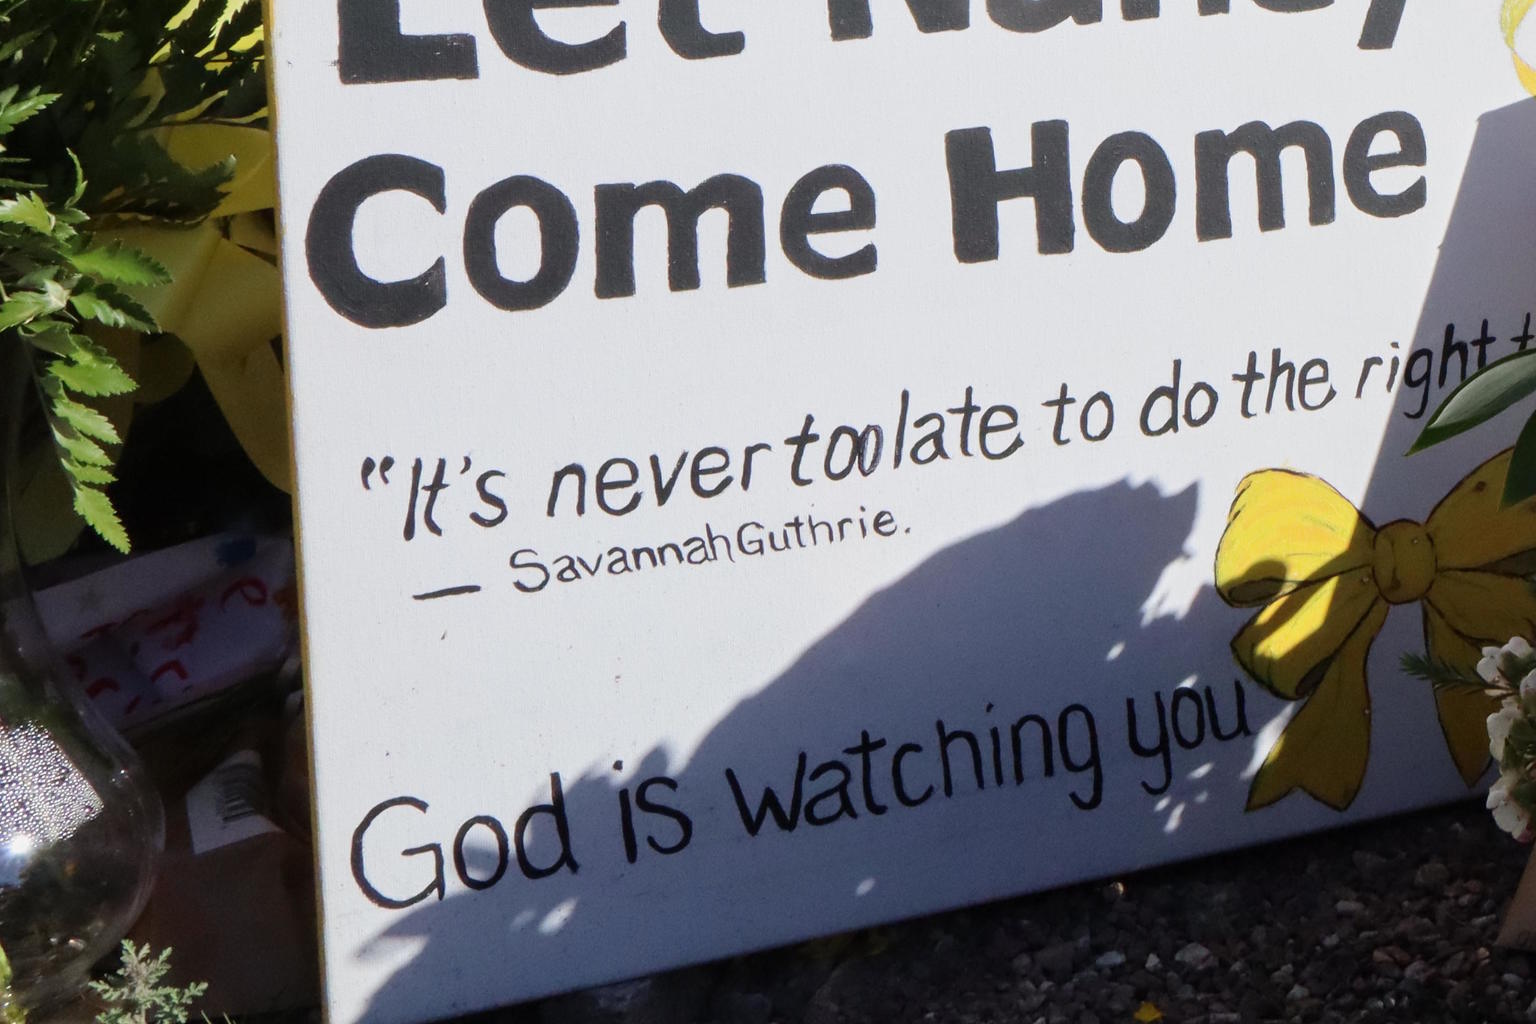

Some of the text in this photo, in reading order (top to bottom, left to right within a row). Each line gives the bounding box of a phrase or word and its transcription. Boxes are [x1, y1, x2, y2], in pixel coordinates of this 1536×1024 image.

[305, 110, 1427, 329] Come Home
[546, 442, 772, 517] never
[1041, 382, 1116, 446] to
[1139, 358, 1219, 437] do
[1231, 347, 1337, 419] the
[1355, 317, 1497, 419] right
[350, 771, 580, 909] God
[613, 760, 694, 863] is
[1125, 677, 1254, 795] you
